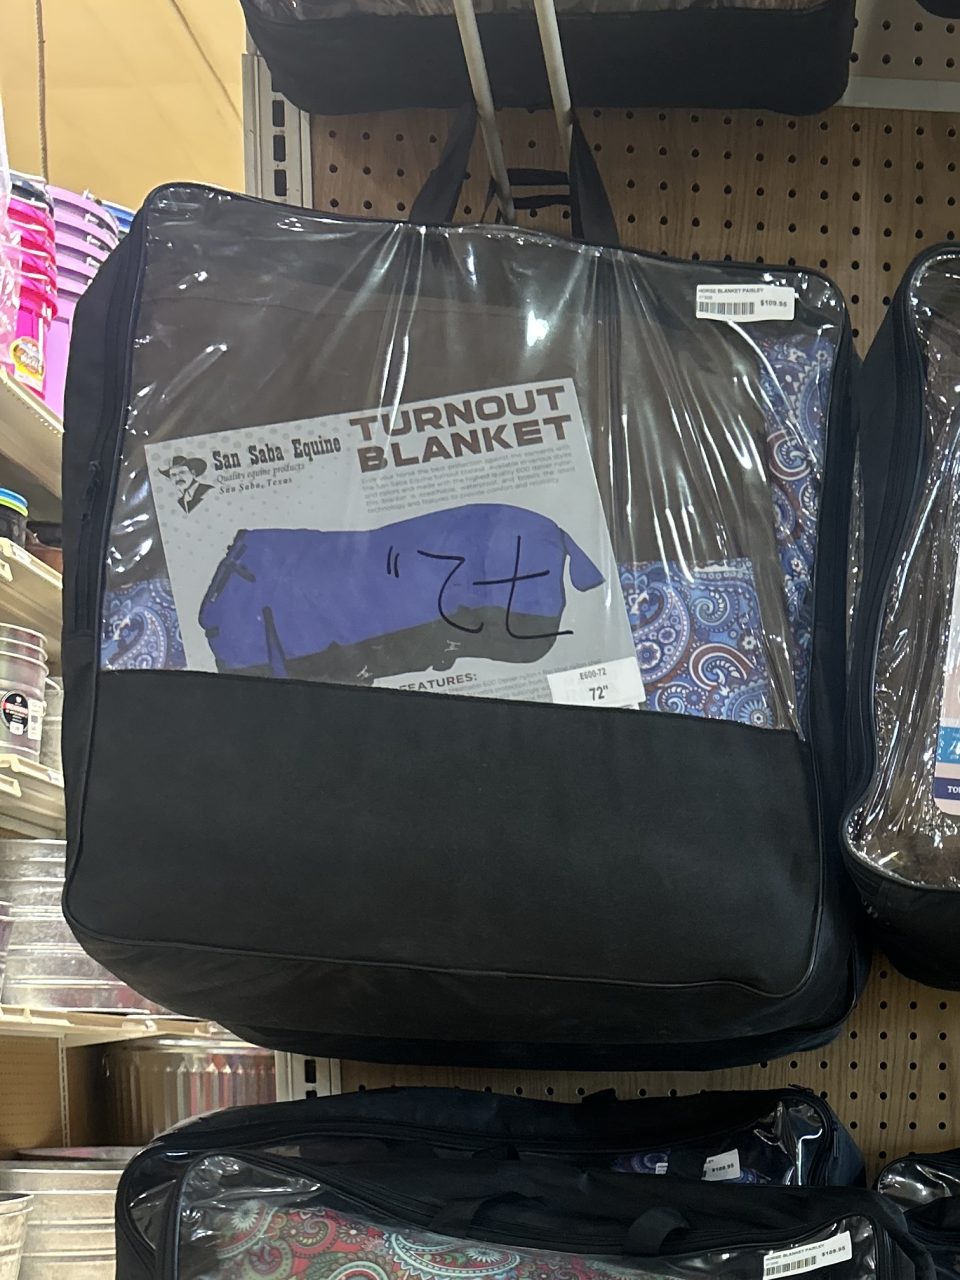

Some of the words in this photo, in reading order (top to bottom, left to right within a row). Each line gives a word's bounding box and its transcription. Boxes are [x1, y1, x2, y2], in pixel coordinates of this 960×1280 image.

[349, 385, 566, 441] TURNOUT
[212, 450, 241, 471] San
[248, 443, 285, 466] Saba
[291, 435, 342, 462] Equine
[357, 414, 572, 473] BLANKET
[266, 477, 293, 488] Texas
[579, 667, 607, 681] E600-72
[589, 685, 609, 702] 72"
